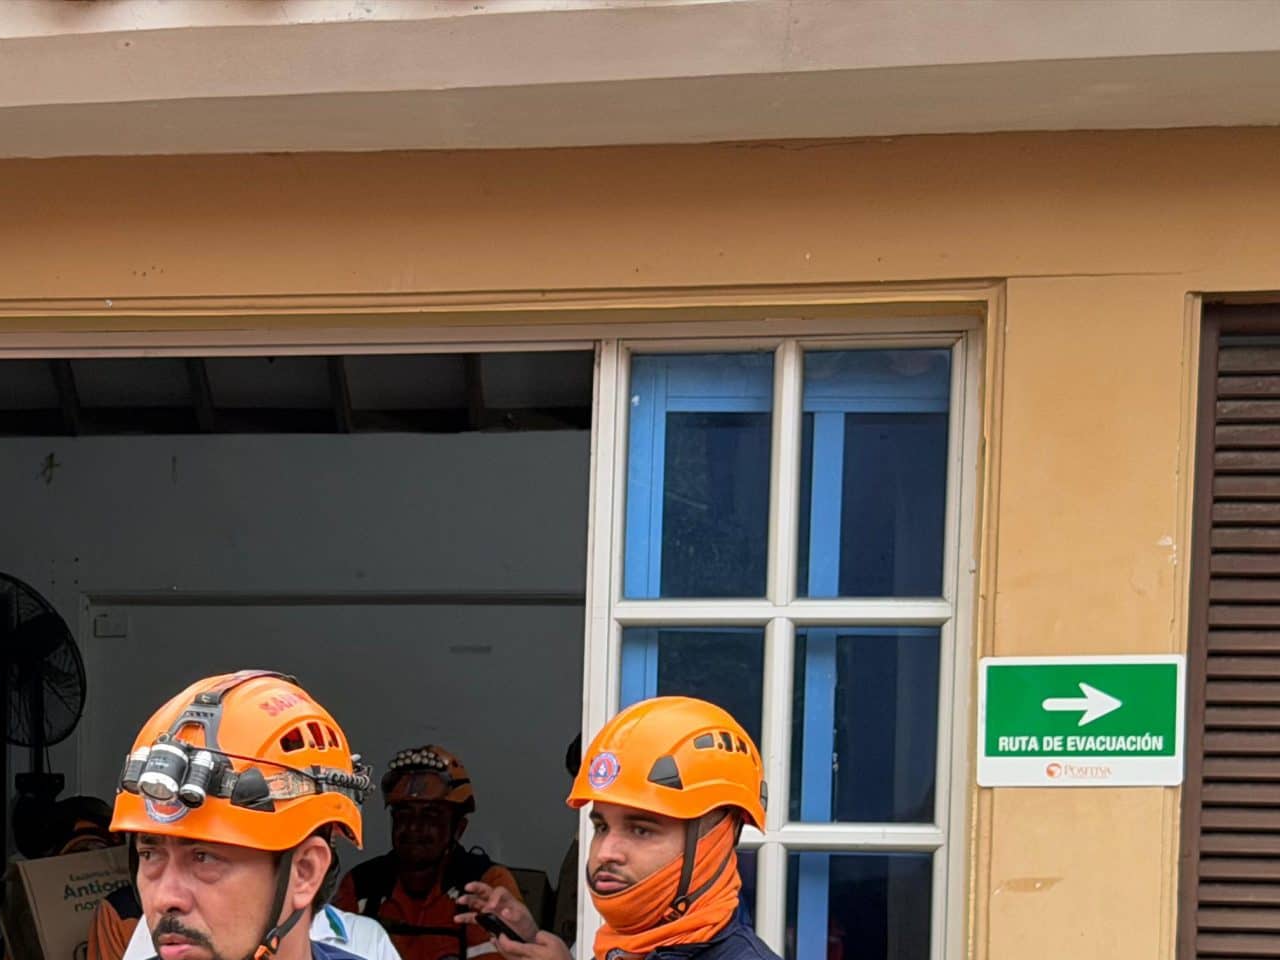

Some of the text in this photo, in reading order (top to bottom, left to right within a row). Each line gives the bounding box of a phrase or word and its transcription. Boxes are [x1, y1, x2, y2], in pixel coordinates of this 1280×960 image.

[998, 732, 1164, 752] RUTA DE EVACUACIÓN
